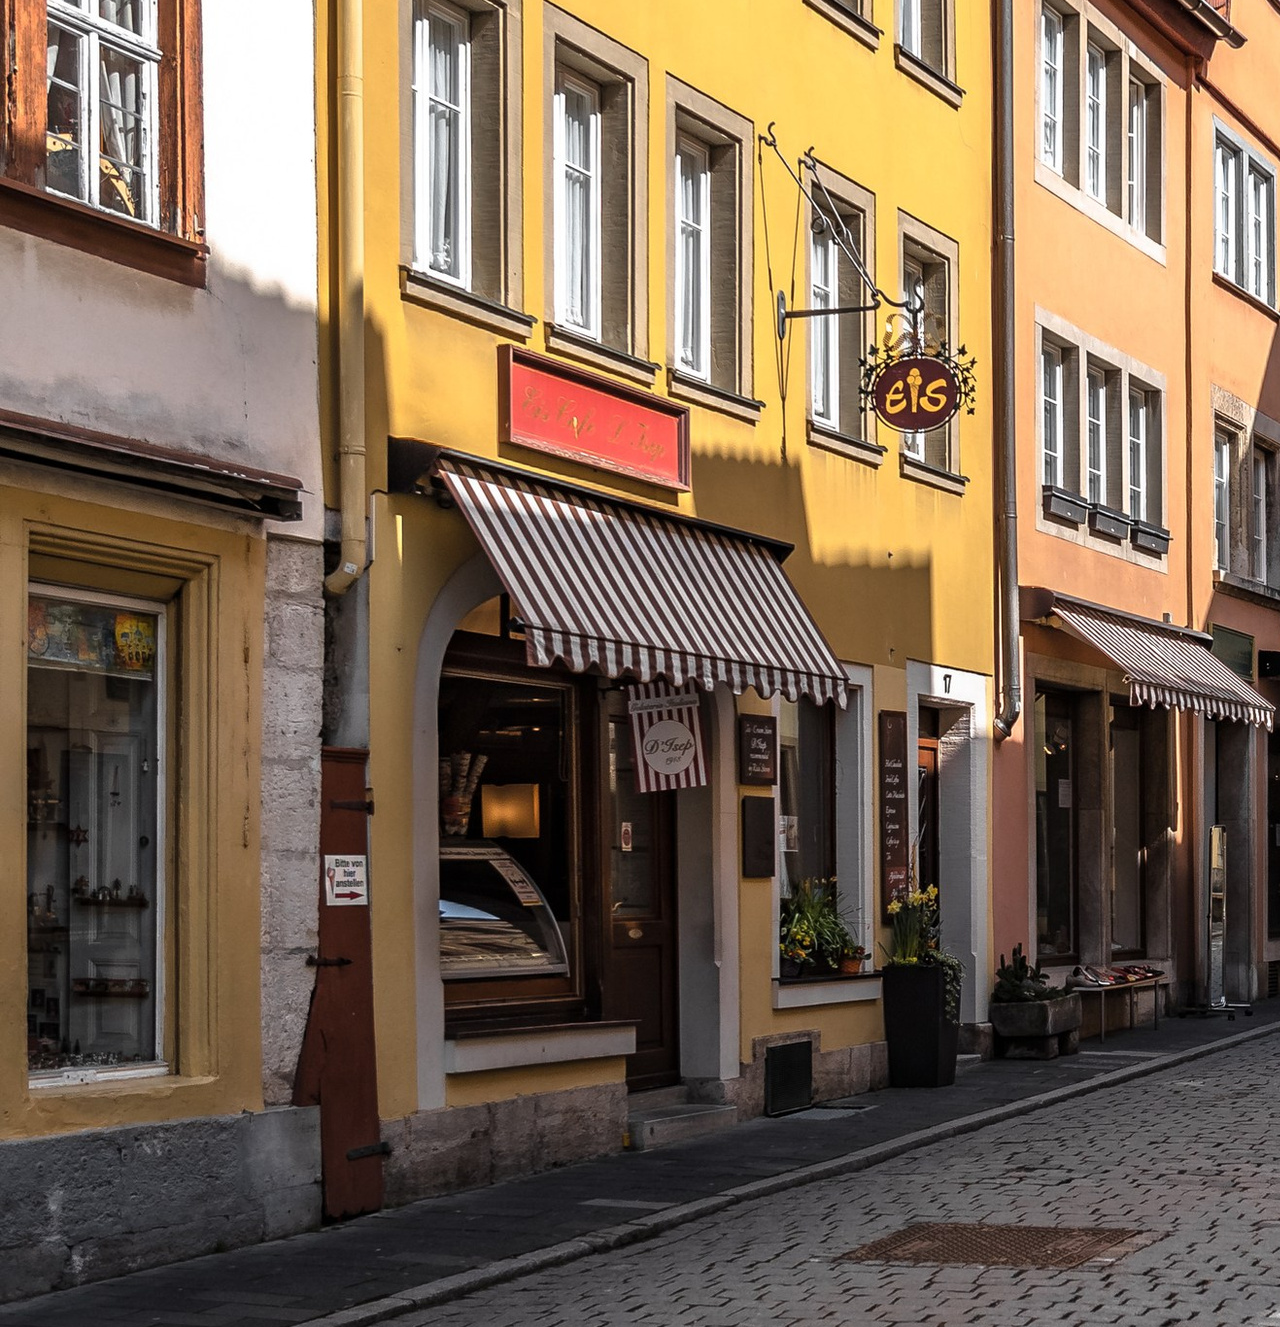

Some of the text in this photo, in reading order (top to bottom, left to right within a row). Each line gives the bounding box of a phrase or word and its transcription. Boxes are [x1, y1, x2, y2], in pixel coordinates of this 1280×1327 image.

[943, 674, 952, 694] 17
[644, 737, 694, 756] D'Isep
[335, 858, 350, 867] Bitte
[343, 869, 356, 877] hier
